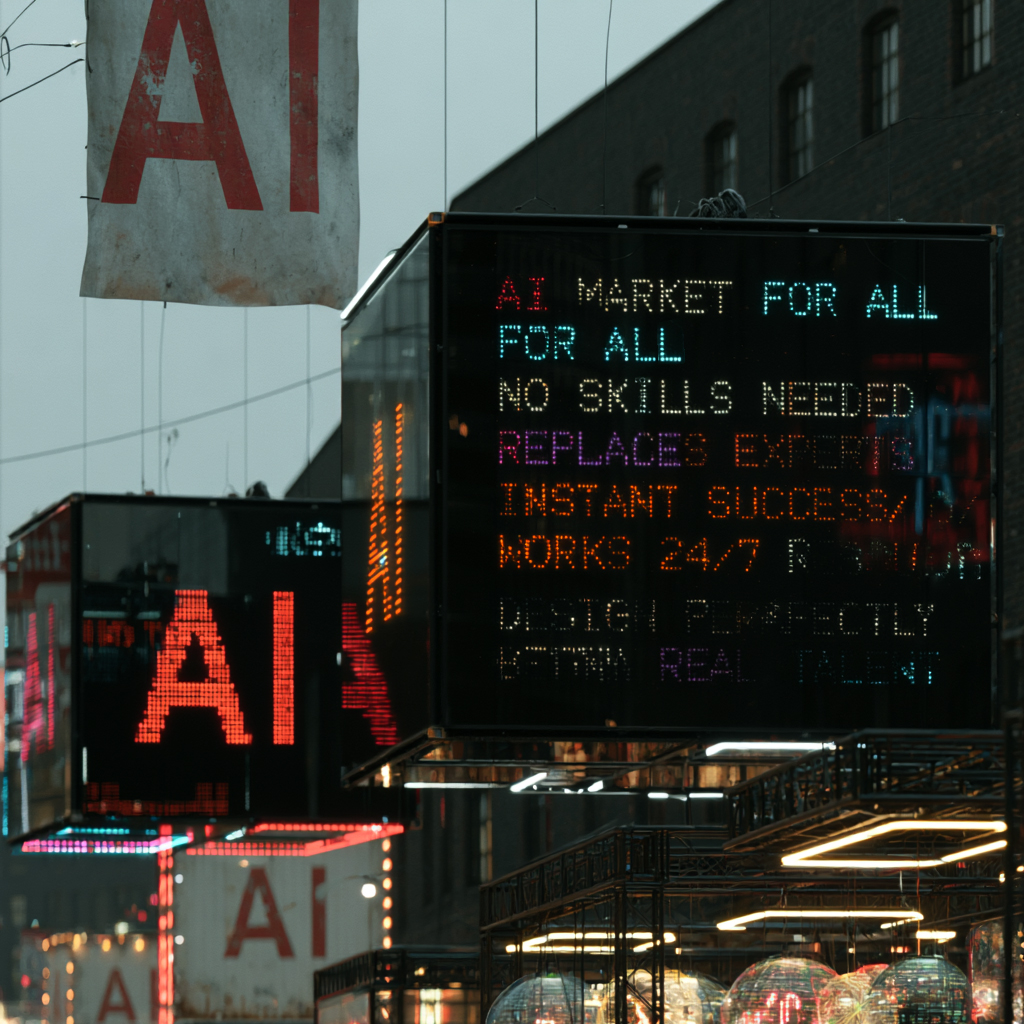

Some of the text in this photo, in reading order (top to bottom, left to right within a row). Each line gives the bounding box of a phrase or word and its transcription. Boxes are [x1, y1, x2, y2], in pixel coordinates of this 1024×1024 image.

[99, 0, 320, 214] AI
[495, 275, 938, 320] AI MARKET FOR ALL
[498, 325, 682, 362] FOR ALL
[498, 376, 915, 418] NO SKILLS NEEDED
[498, 430, 708, 467] REPLACES
[498, 482, 679, 518] INSTANT
[497, 534, 632, 570] WORKS
[659, 536, 762, 573] 24/7
[134, 590, 296, 746] AI
[658, 646, 756, 683] REAL
[224, 866, 328, 959] AI
